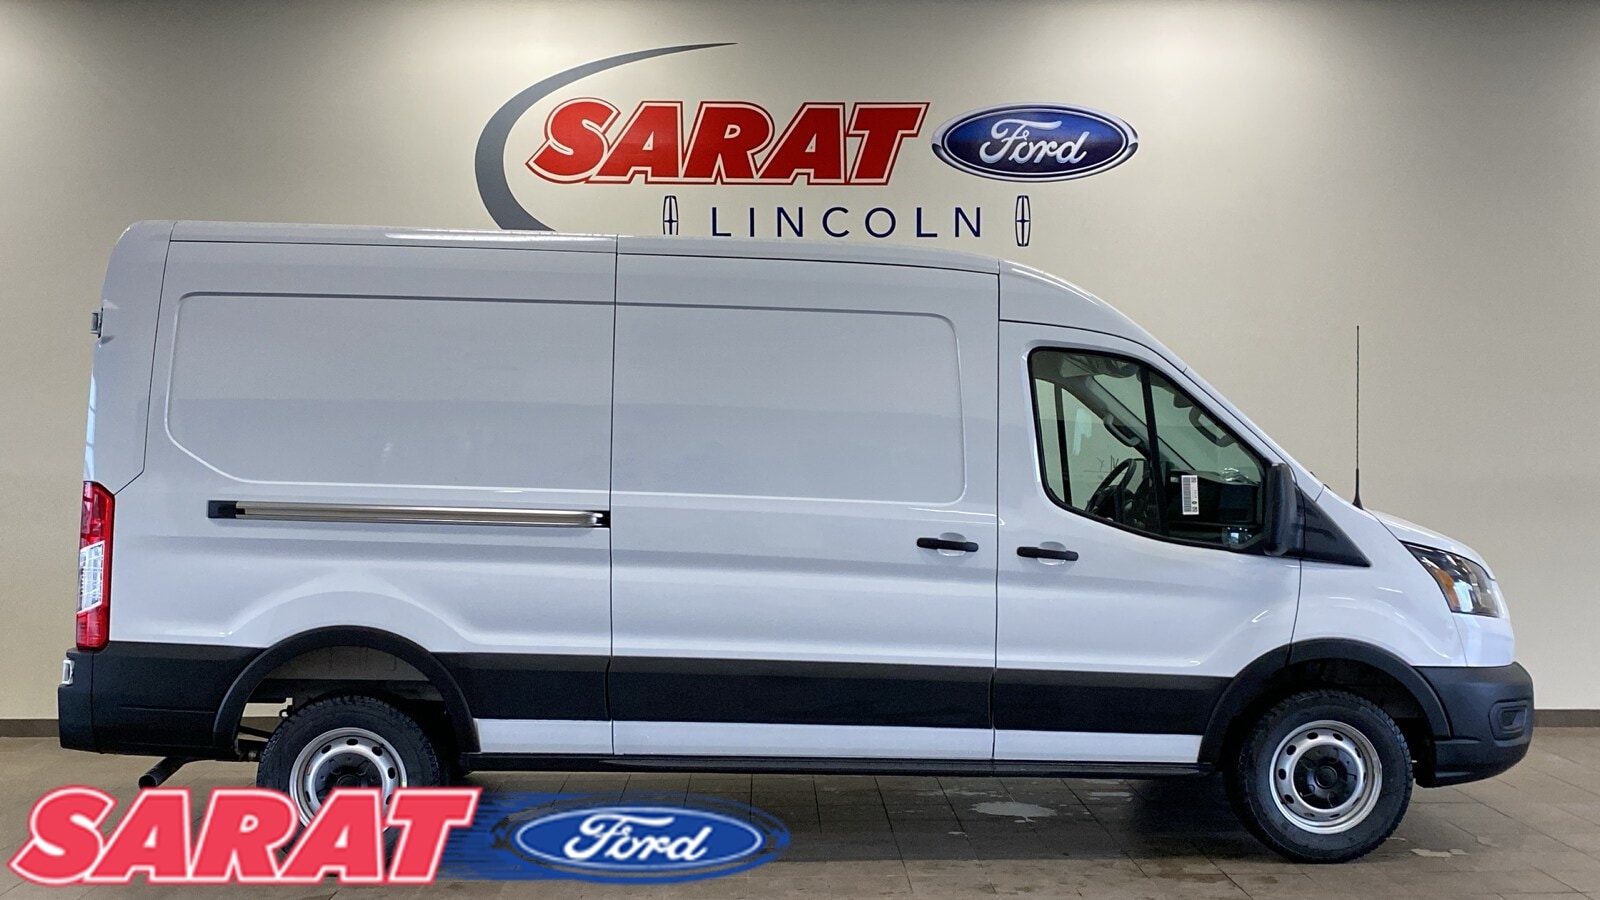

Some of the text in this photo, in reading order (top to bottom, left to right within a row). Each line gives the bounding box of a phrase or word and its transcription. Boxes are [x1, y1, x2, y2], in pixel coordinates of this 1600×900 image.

[526, 98, 1088, 185] SARAT Ford
[711, 206, 982, 238] LINCOLN
